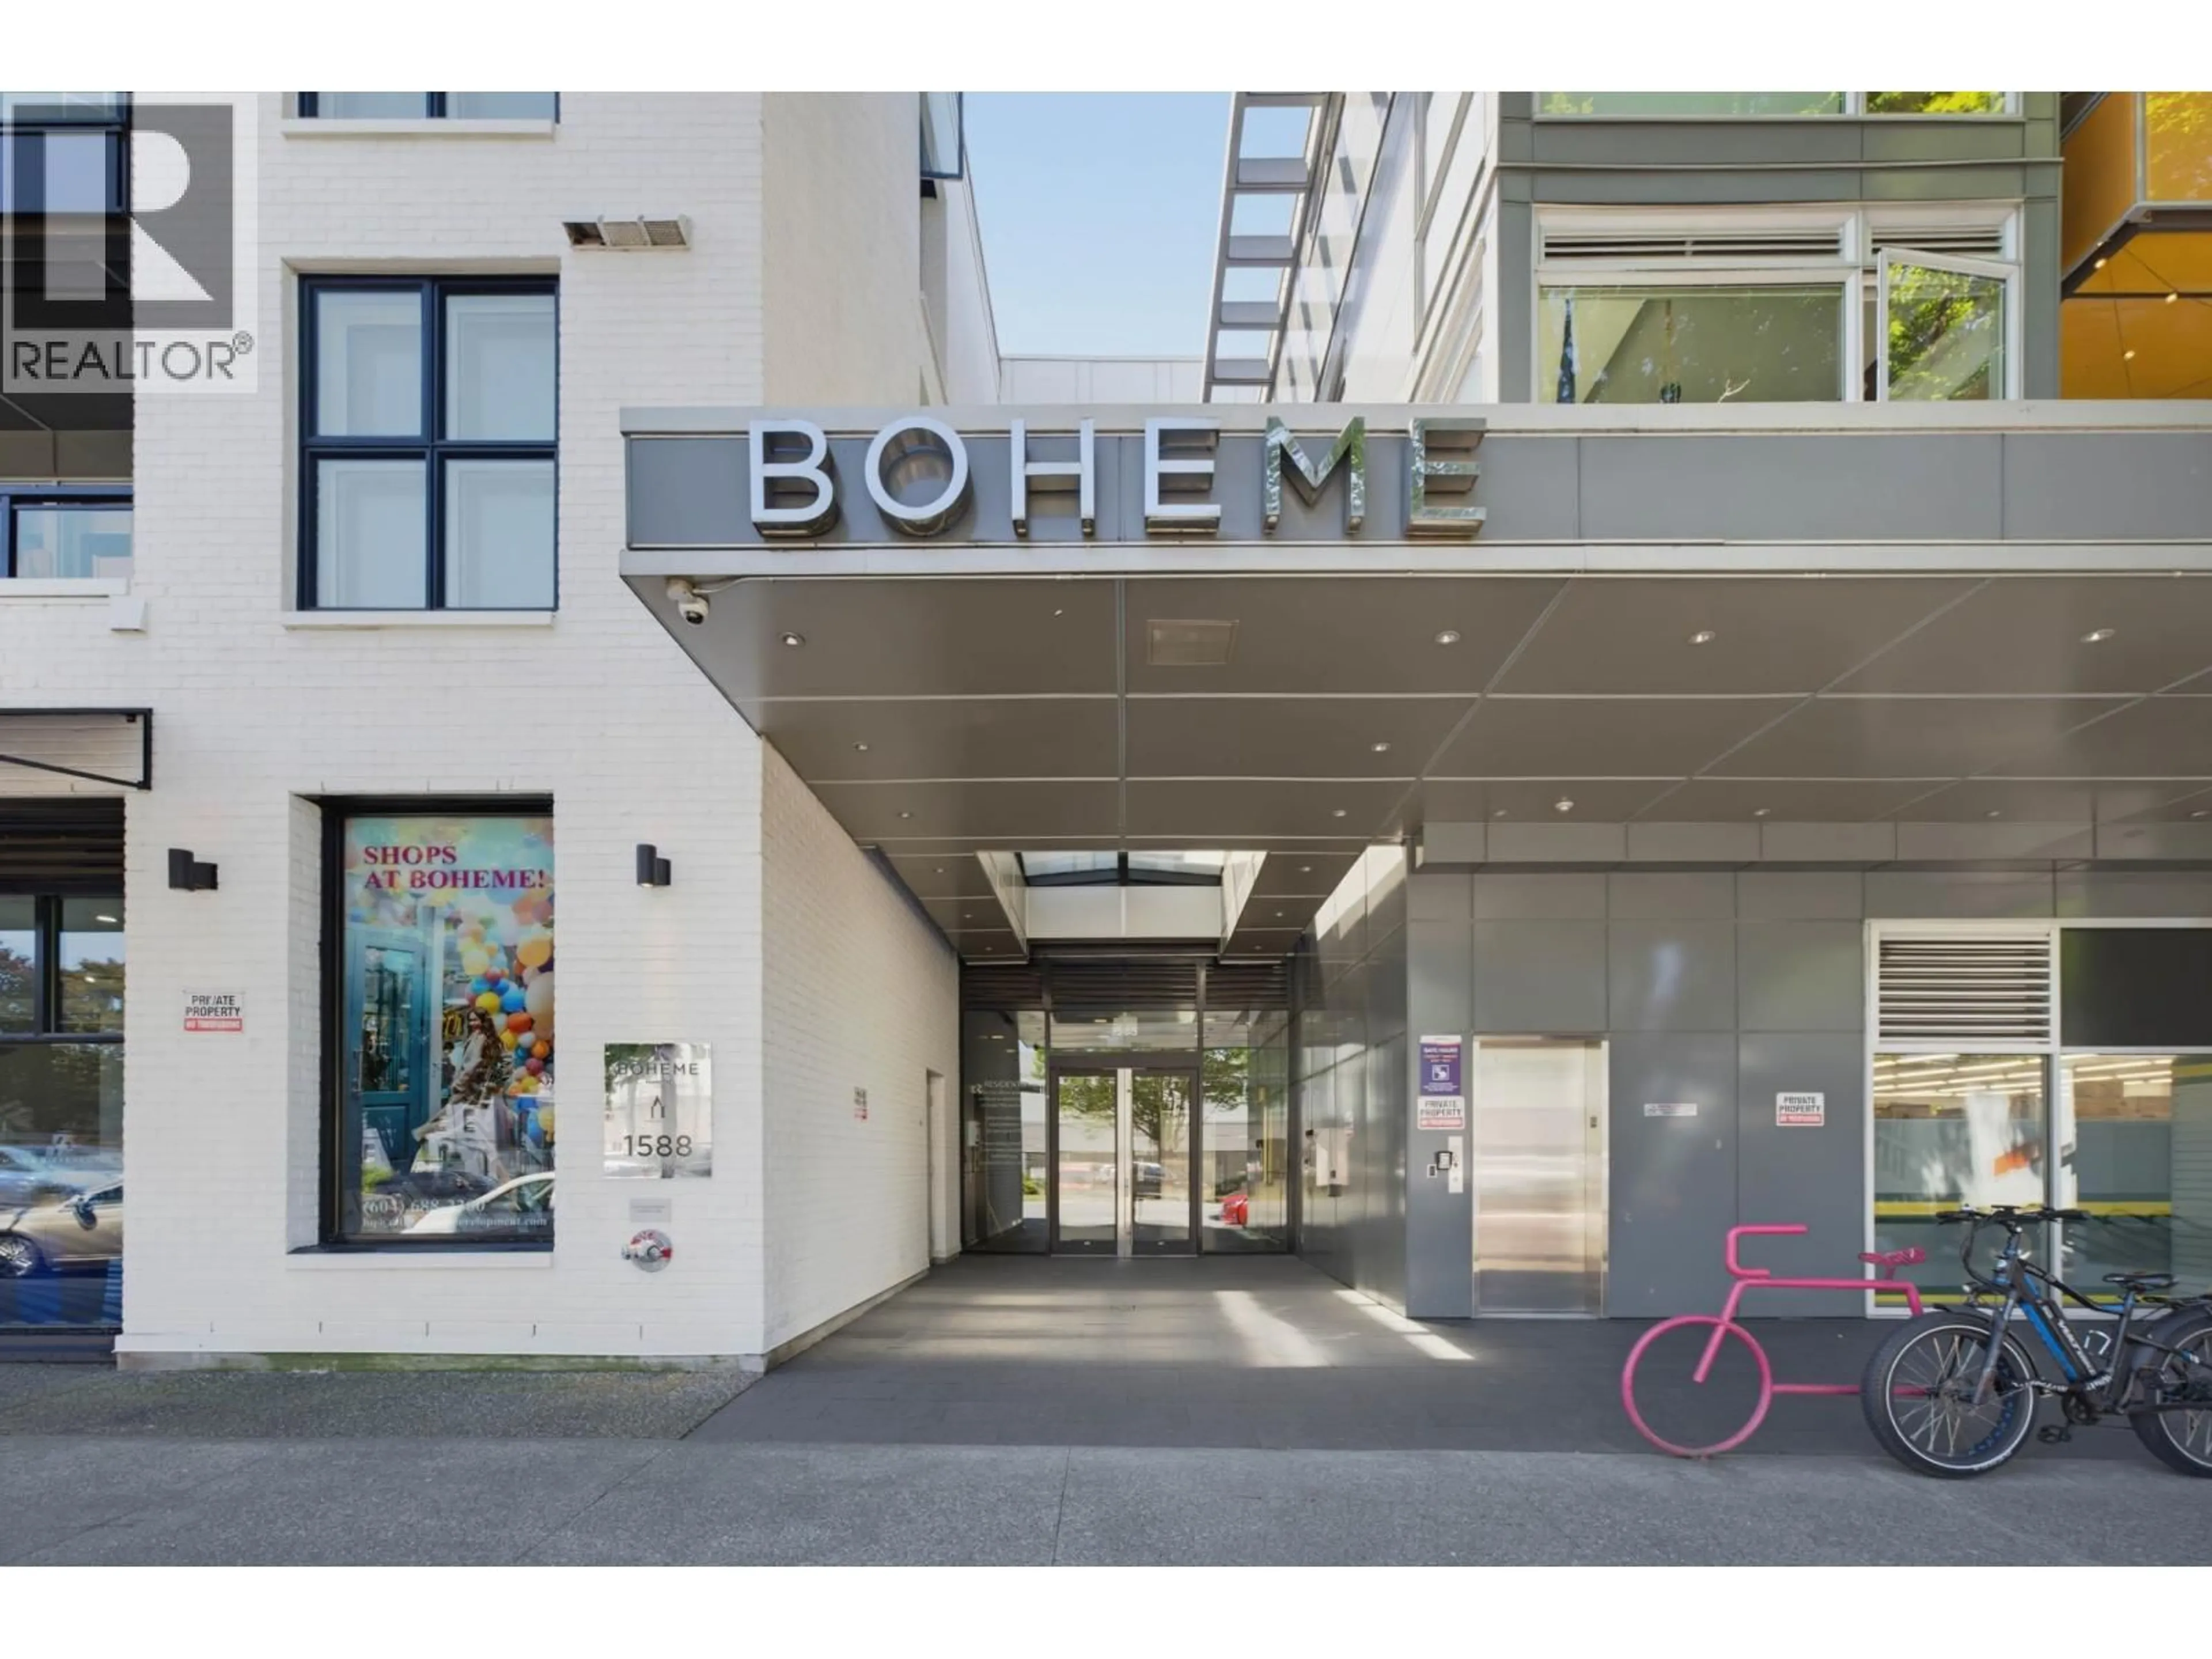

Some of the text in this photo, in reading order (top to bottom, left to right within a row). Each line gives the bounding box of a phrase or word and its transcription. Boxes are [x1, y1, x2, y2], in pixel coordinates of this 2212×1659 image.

[749, 416, 1488, 535] BOHEME
[363, 846, 457, 864] SHOPS
[365, 869, 546, 889] AT BOHEME!
[185, 1006, 241, 1017] PROPERTY
[617, 1063, 699, 1075] BOHEME
[624, 1134, 693, 1157] 1588
